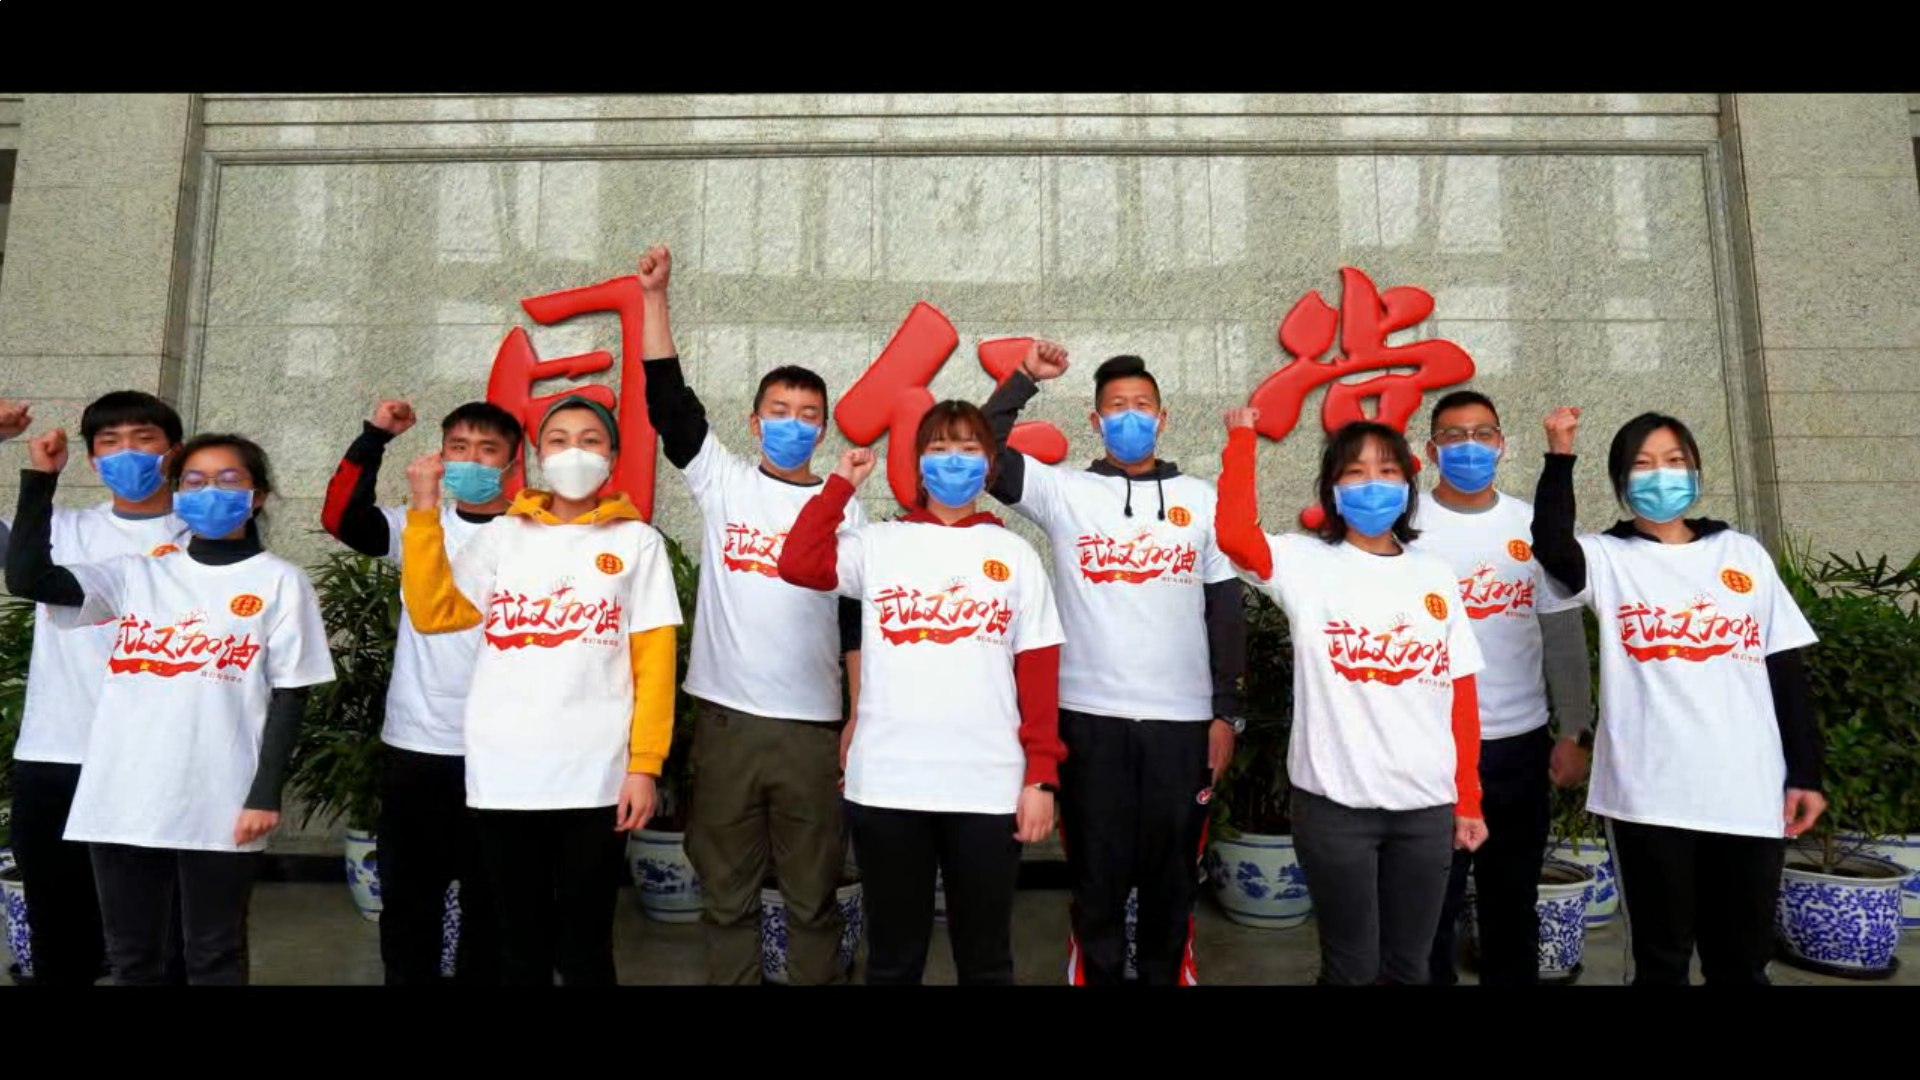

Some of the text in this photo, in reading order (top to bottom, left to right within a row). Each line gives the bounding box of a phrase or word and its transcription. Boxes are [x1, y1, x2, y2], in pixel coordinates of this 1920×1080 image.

[1076, 533, 1198, 575] 武汉加油
[485, 588, 622, 635] 武汉加油
[874, 585, 1014, 636] 武汉加油
[1615, 603, 1761, 650] 武汉加油
[113, 612, 261, 671] 武汉加油
[1322, 619, 1451, 677] 武汉加油
